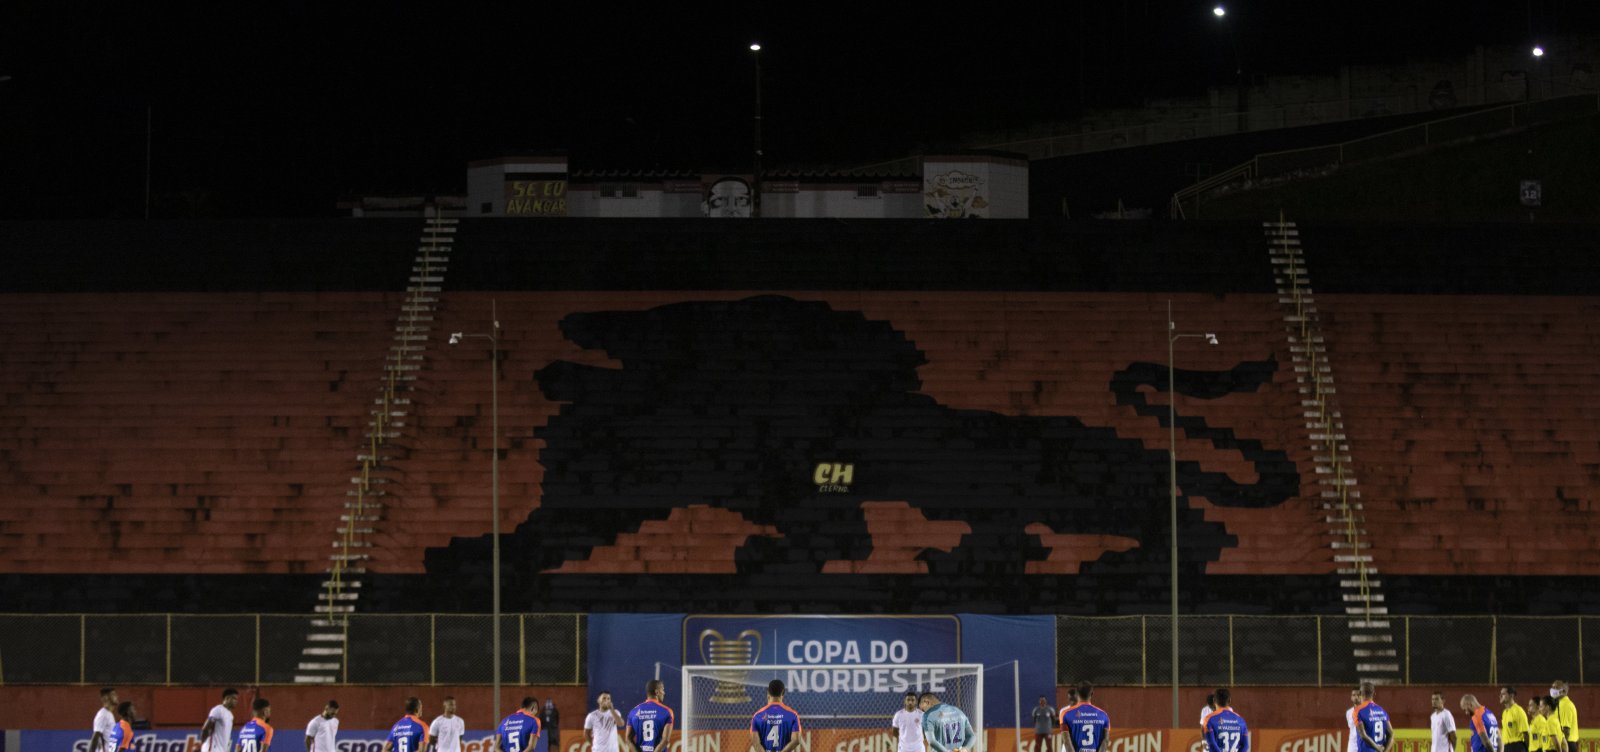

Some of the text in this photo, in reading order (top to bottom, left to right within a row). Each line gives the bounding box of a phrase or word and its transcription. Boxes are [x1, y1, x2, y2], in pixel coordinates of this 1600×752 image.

[512, 180, 536, 197] SE
[813, 462, 855, 484] CH
[787, 640, 909, 664] COPA DO
[787, 669, 947, 693] NORDESTE
[642, 720, 654, 741] 8
[766, 725, 779, 747] 4
[944, 722, 962, 744] 12
[1081, 725, 1094, 746] 3
[1374, 721, 1384, 743] 9
[398, 737, 408, 752] 6
[508, 732, 520, 752] 5
[1218, 732, 1241, 752] 32
